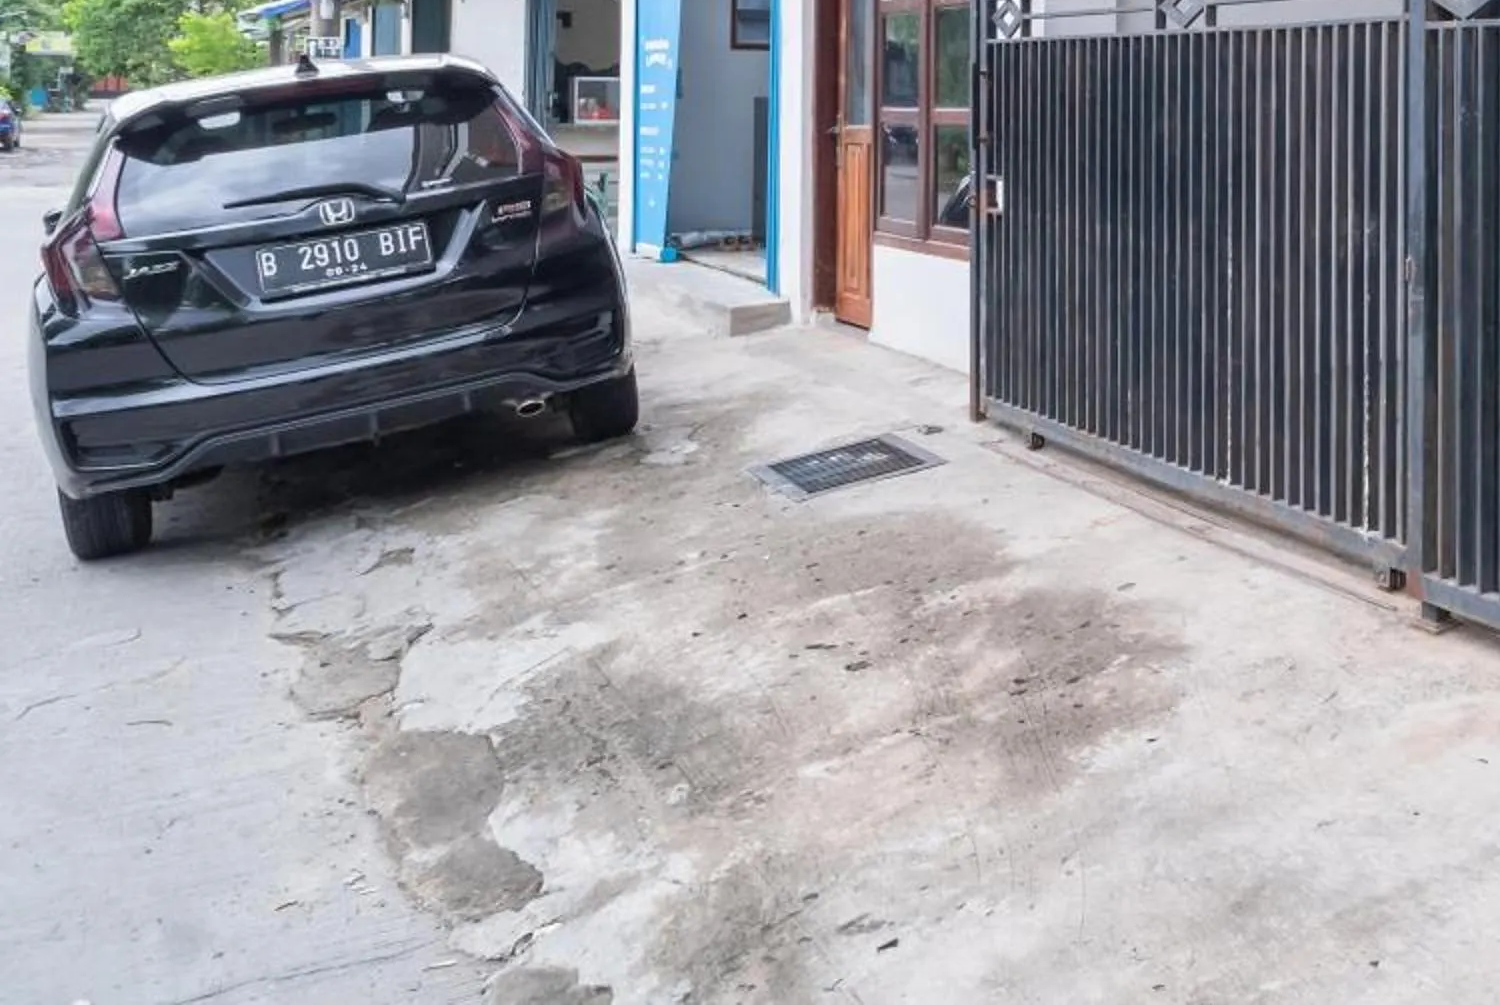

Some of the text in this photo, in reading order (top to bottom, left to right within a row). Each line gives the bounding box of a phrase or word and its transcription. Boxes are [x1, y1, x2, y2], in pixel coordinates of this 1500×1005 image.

[261, 226, 424, 277] B 2910 BIF
